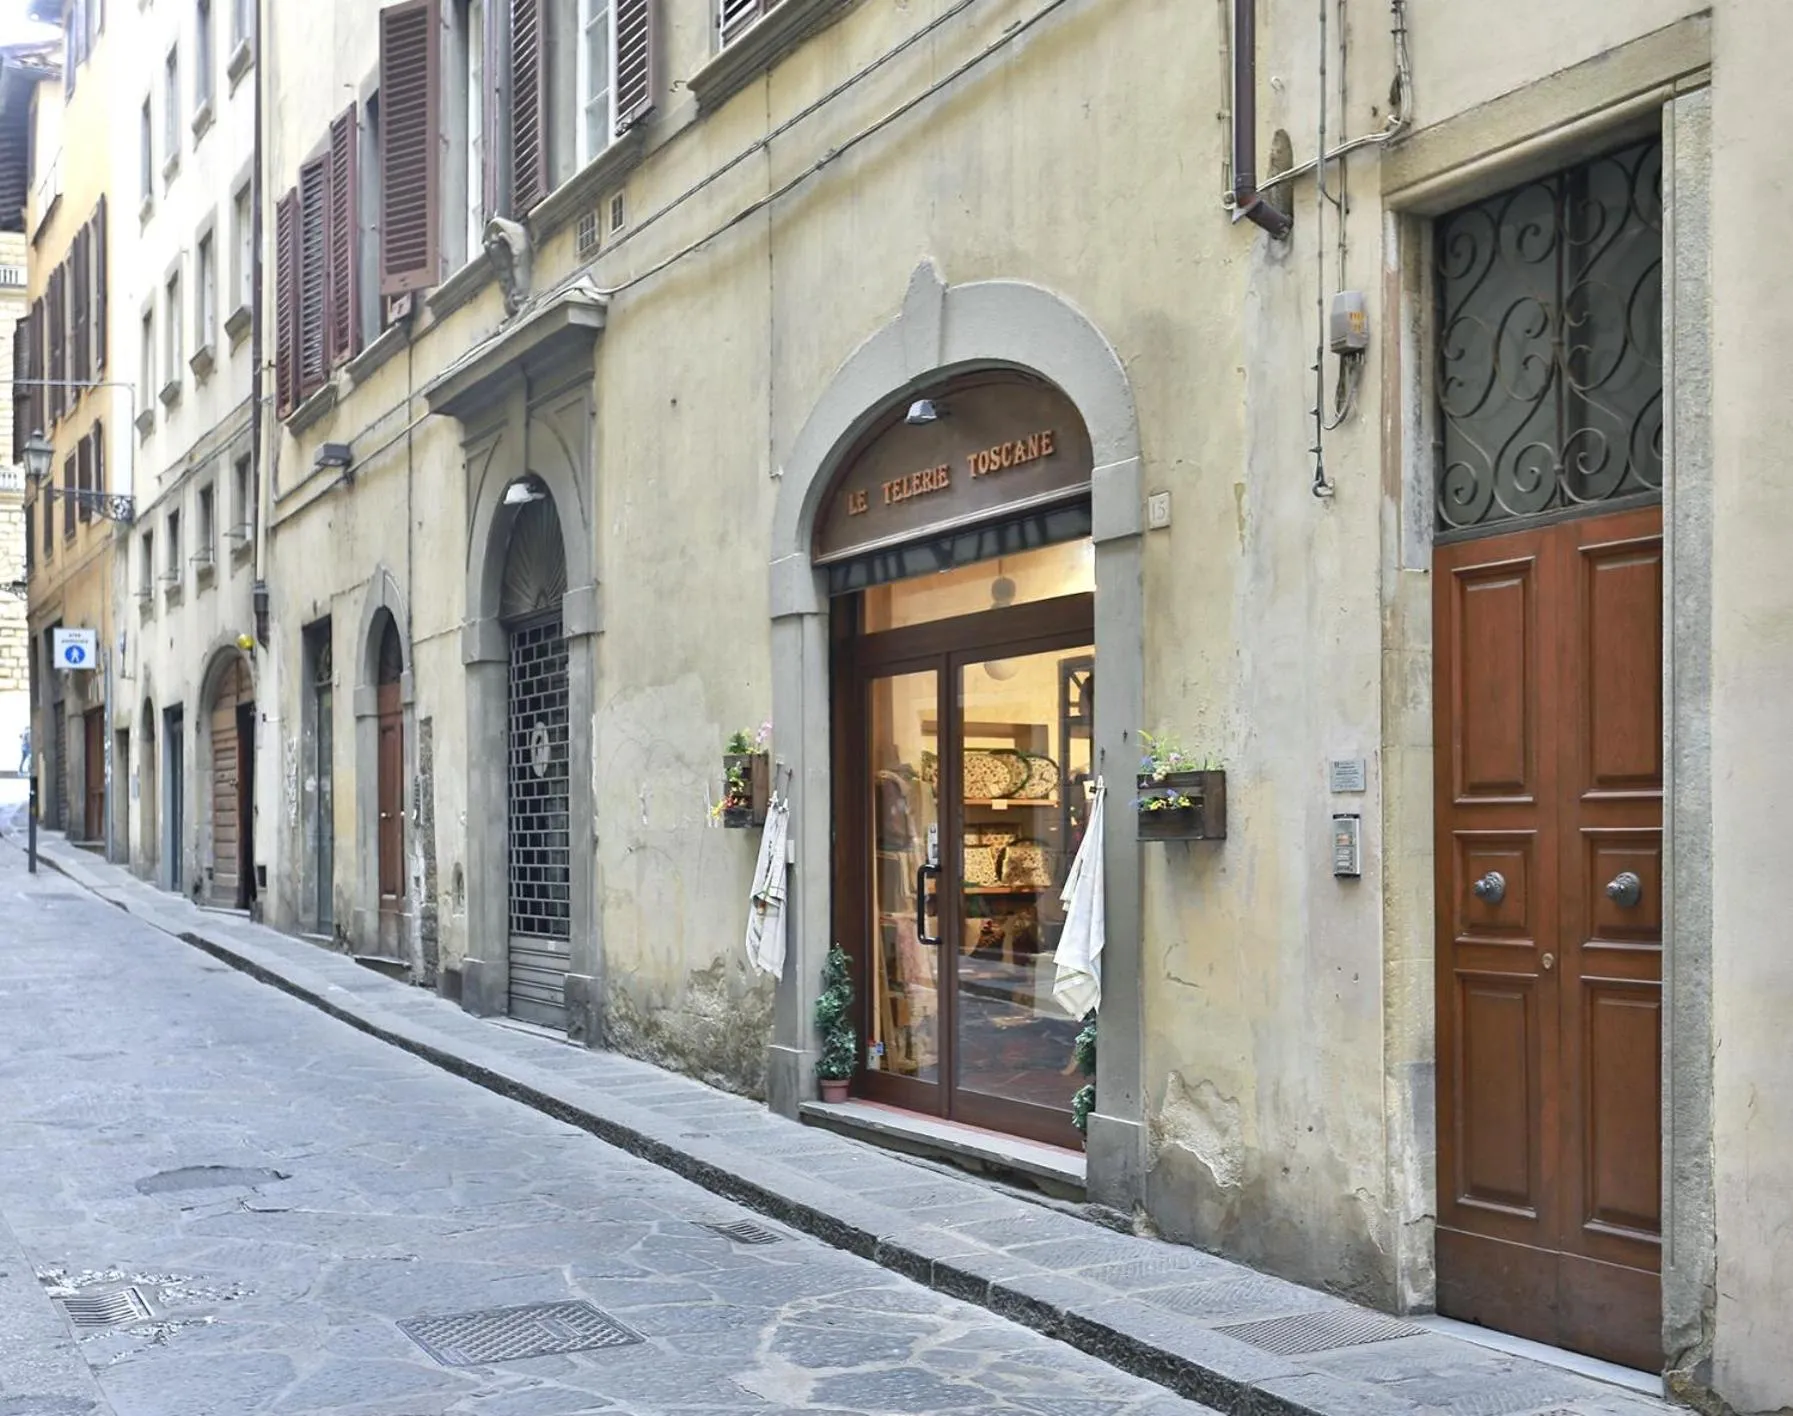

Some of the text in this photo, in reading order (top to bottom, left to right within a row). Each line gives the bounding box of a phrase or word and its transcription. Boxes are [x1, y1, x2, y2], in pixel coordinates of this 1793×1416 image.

[847, 431, 1054, 516] LE TELERIE TOSCANE
